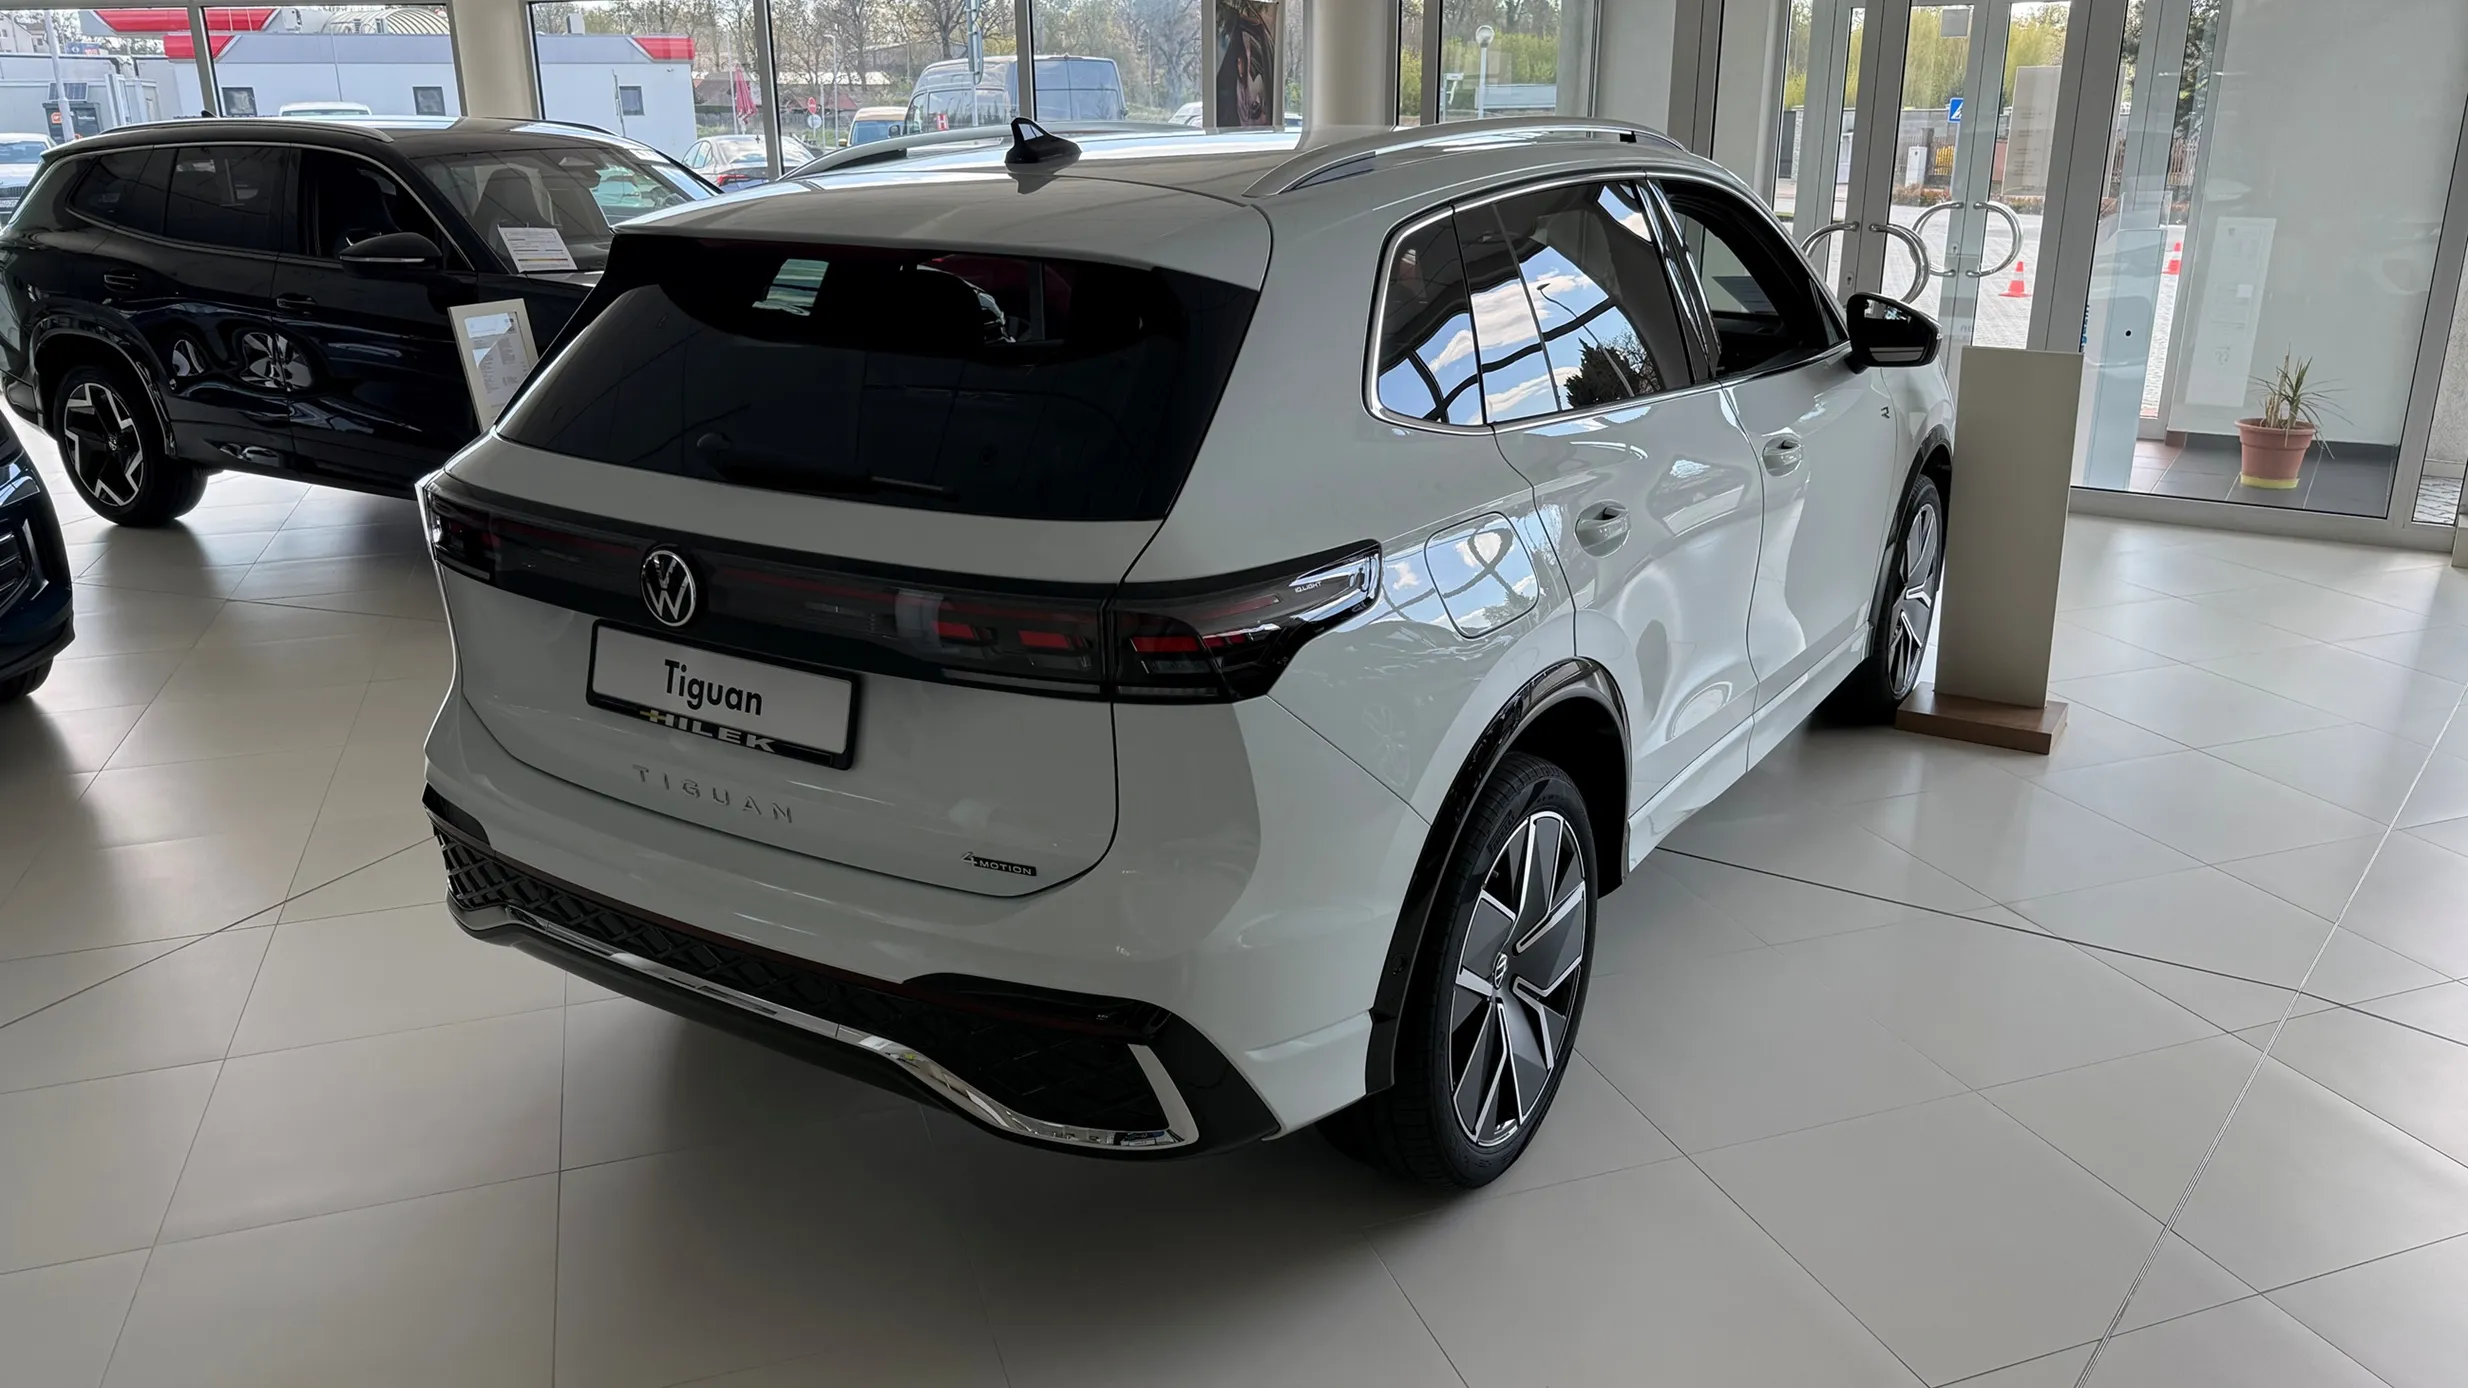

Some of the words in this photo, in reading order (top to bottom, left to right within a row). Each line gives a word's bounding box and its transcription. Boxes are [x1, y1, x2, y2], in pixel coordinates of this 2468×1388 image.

[664, 658, 763, 716] Tiguan
[649, 709, 775, 753] HILEK
[632, 764, 793, 824] TIGUAN
